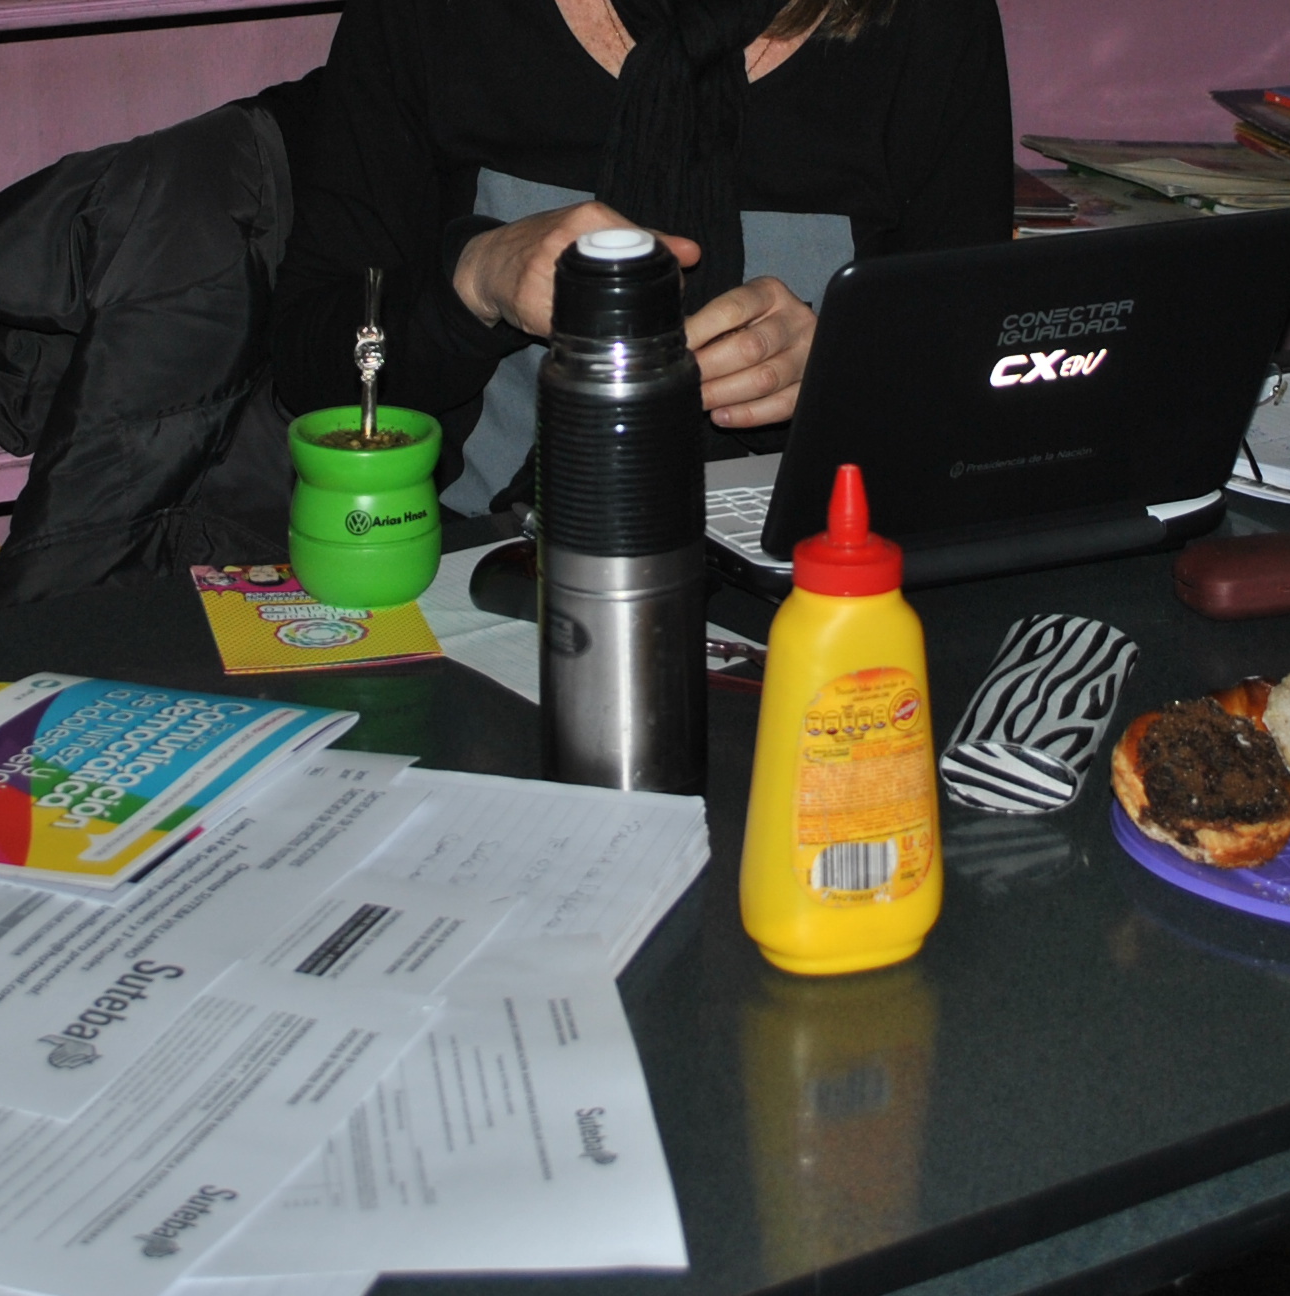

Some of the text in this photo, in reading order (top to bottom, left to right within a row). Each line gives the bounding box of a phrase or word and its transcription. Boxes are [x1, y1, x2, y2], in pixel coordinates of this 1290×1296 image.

[1003, 299, 1135, 330] CONECTAR
[965, 446, 1093, 473] Presidencia de la Nación
[372, 511, 402, 529] Arias
[100, 686, 146, 702] la
[14, 690, 176, 780] de la Niñez y
[30, 696, 211, 810] democrática
[48, 705, 256, 830] Comunicación
[211, 835, 235, 847] 14
[222, 816, 258, 838] Lunes
[186, 847, 243, 885] encuentros
[201, 843, 222, 855] de
[150, 850, 212, 892] Septiembre
[120, 887, 164, 915] primer
[131, 881, 199, 927] presenciales
[169, 889, 216, 920] SUTEBA
[73, 911, 134, 953] encuentro
[120, 916, 182, 960] VILLARINO
[77, 935, 132, 973] virtuales
[57, 957, 186, 1042] Suteba
[574, 1105, 607, 1162] Suteba
[167, 1183, 238, 1240] Suteba
